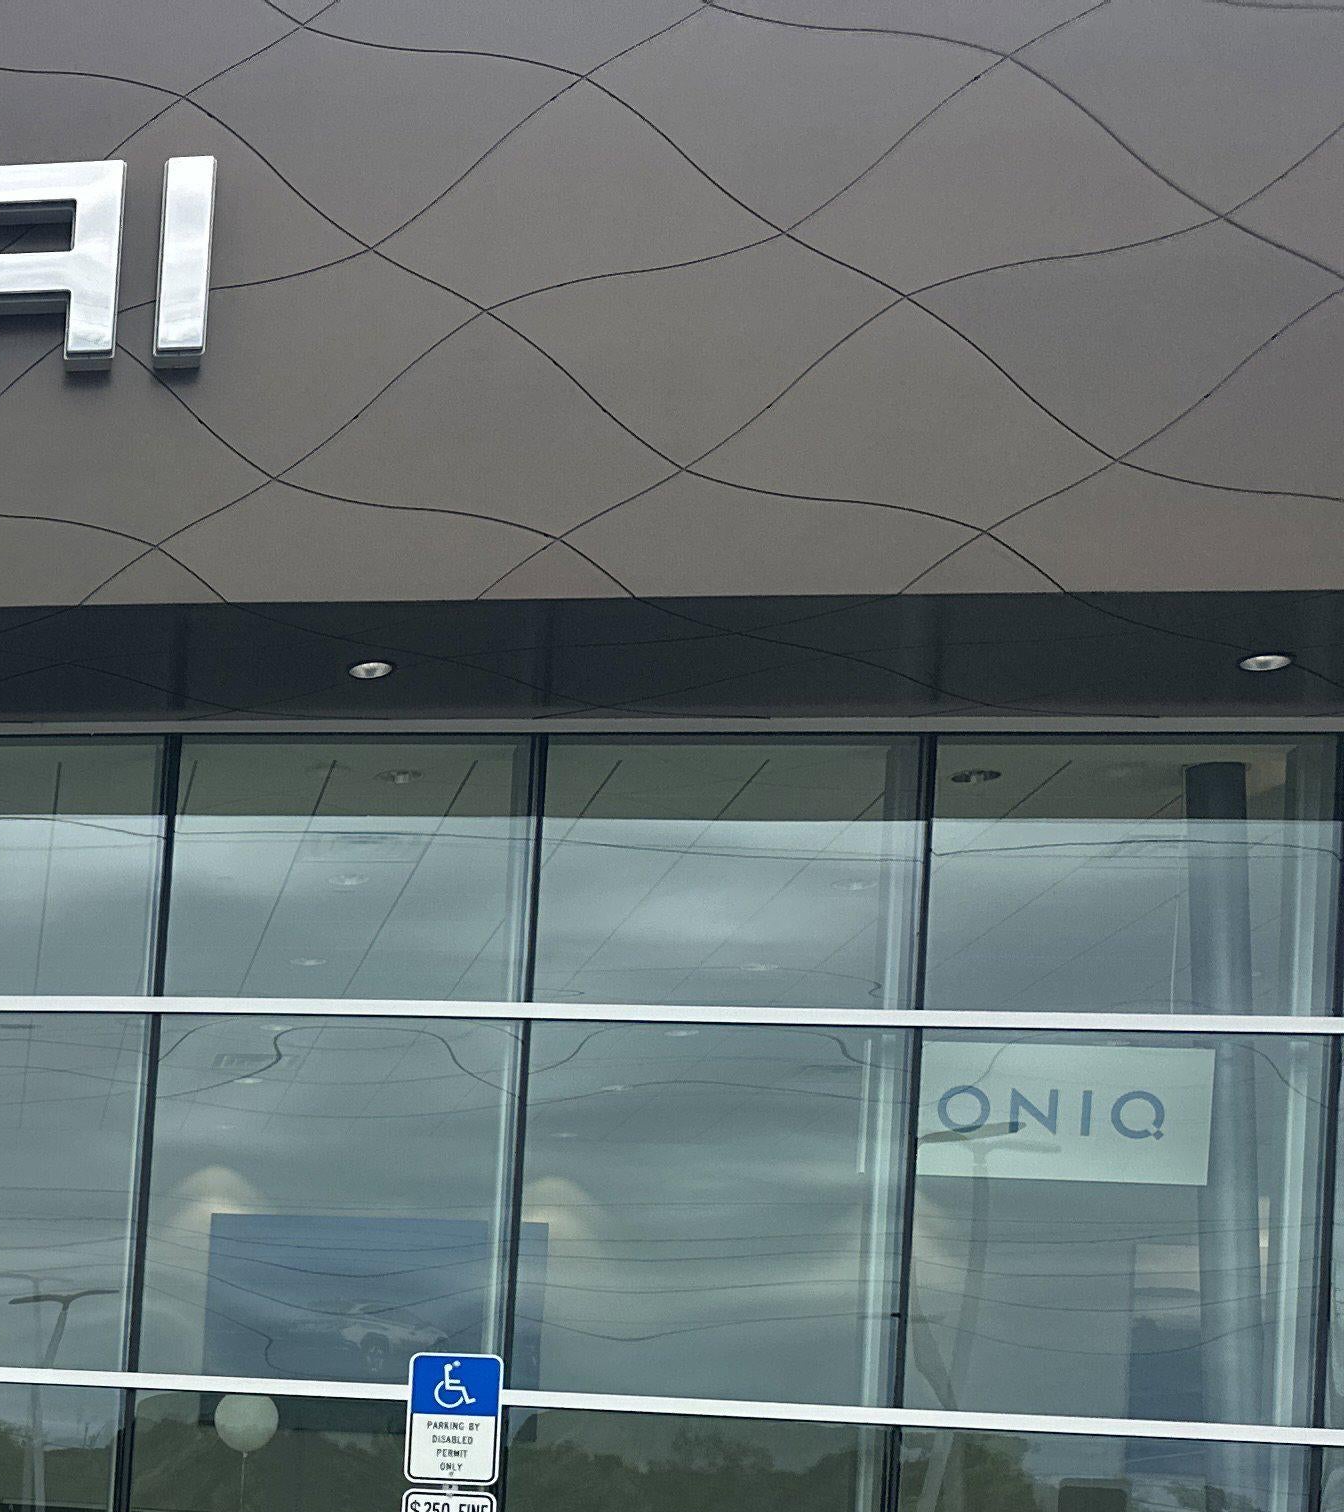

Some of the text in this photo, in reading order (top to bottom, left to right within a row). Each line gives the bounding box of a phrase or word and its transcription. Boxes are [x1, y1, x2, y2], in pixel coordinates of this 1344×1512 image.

[937, 1085, 1166, 1141] ONIQ
[426, 1420, 481, 1432] PARKING BY
[432, 1434, 474, 1445] DISABLED
[436, 1448, 468, 1458] PERMIT
[439, 1461, 463, 1471] ONLY
